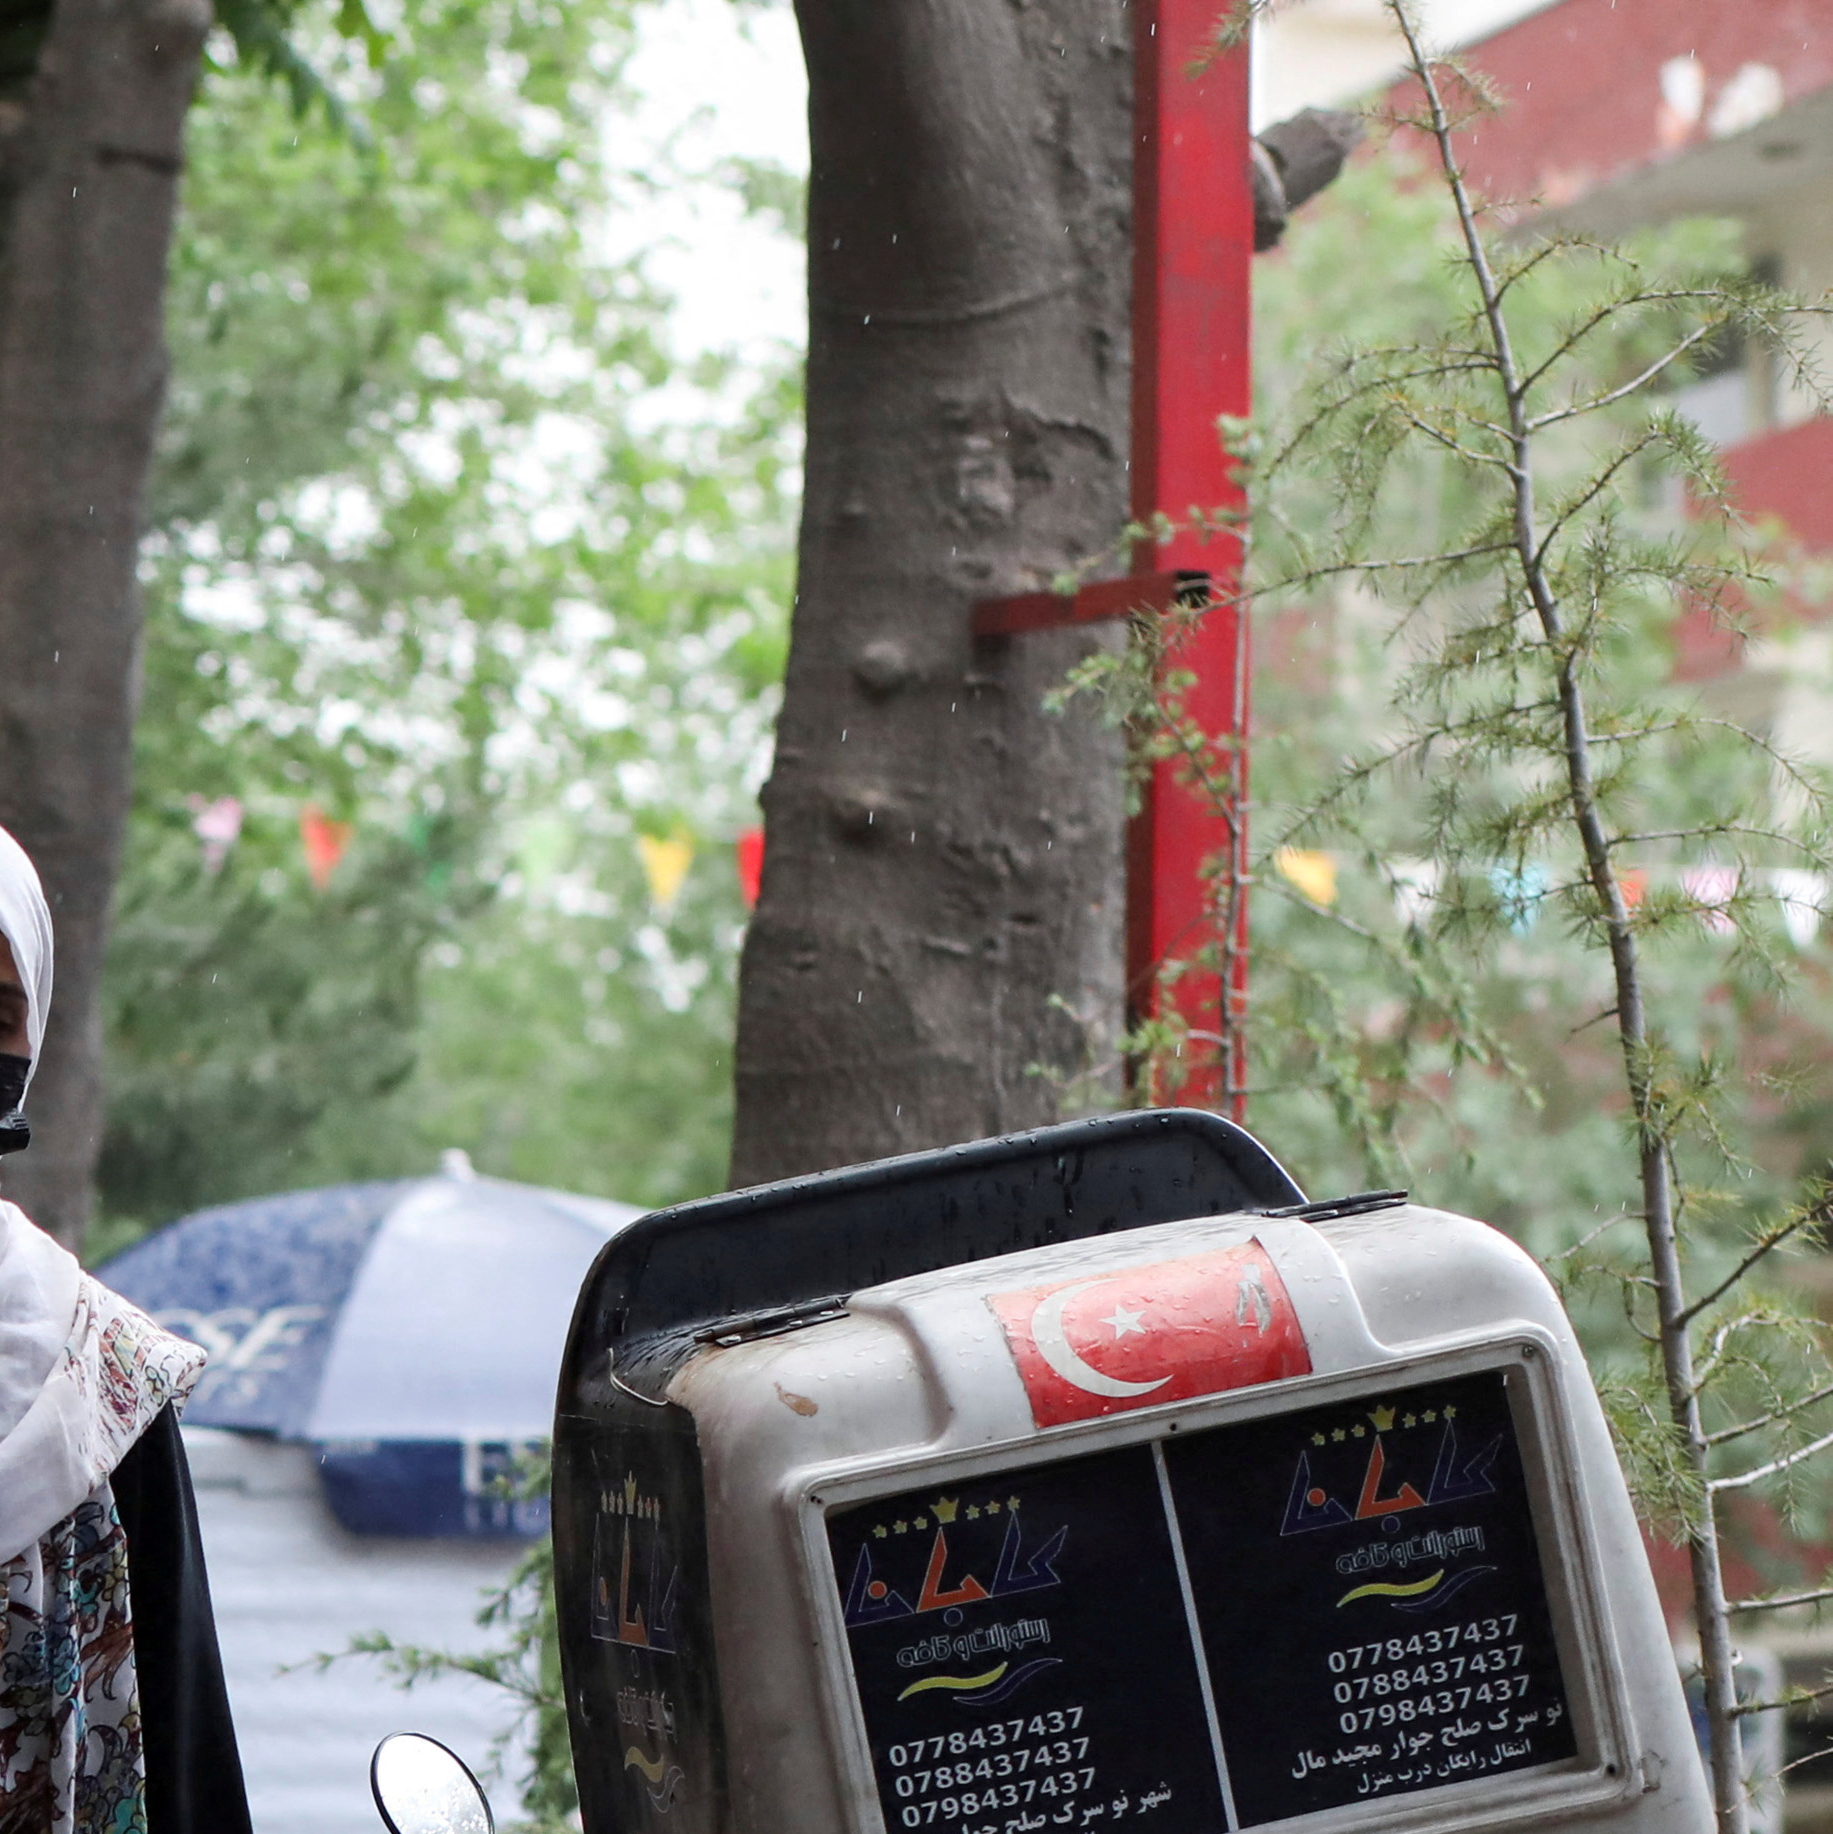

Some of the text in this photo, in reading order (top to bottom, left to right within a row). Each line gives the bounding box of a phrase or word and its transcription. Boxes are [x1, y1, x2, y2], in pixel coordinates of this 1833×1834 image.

[1335, 1541, 1388, 1574] کافه
[895, 1634, 949, 1668] کافه
[1327, 1613, 1519, 1674] 0778437437
[1333, 1643, 1525, 1704] 0788437437
[1339, 1674, 1531, 1735] 0798437437
[887, 1705, 1085, 1768] 0778437437
[1389, 1731, 1434, 1761] جوار
[1440, 1718, 1482, 1747] صلح
[894, 1735, 1091, 1798] 0788437437
[1290, 1749, 1327, 1780] مال
[1331, 1743, 1382, 1768] مجید
[1489, 1738, 1532, 1765] انتقال
[1357, 1772, 1393, 1794] منزل
[1397, 1761, 1432, 1783] درب
[900, 1766, 1097, 1829] 0798437437
[1112, 1788, 1129, 1819] نو
[1136, 1781, 1172, 1815] شهر
